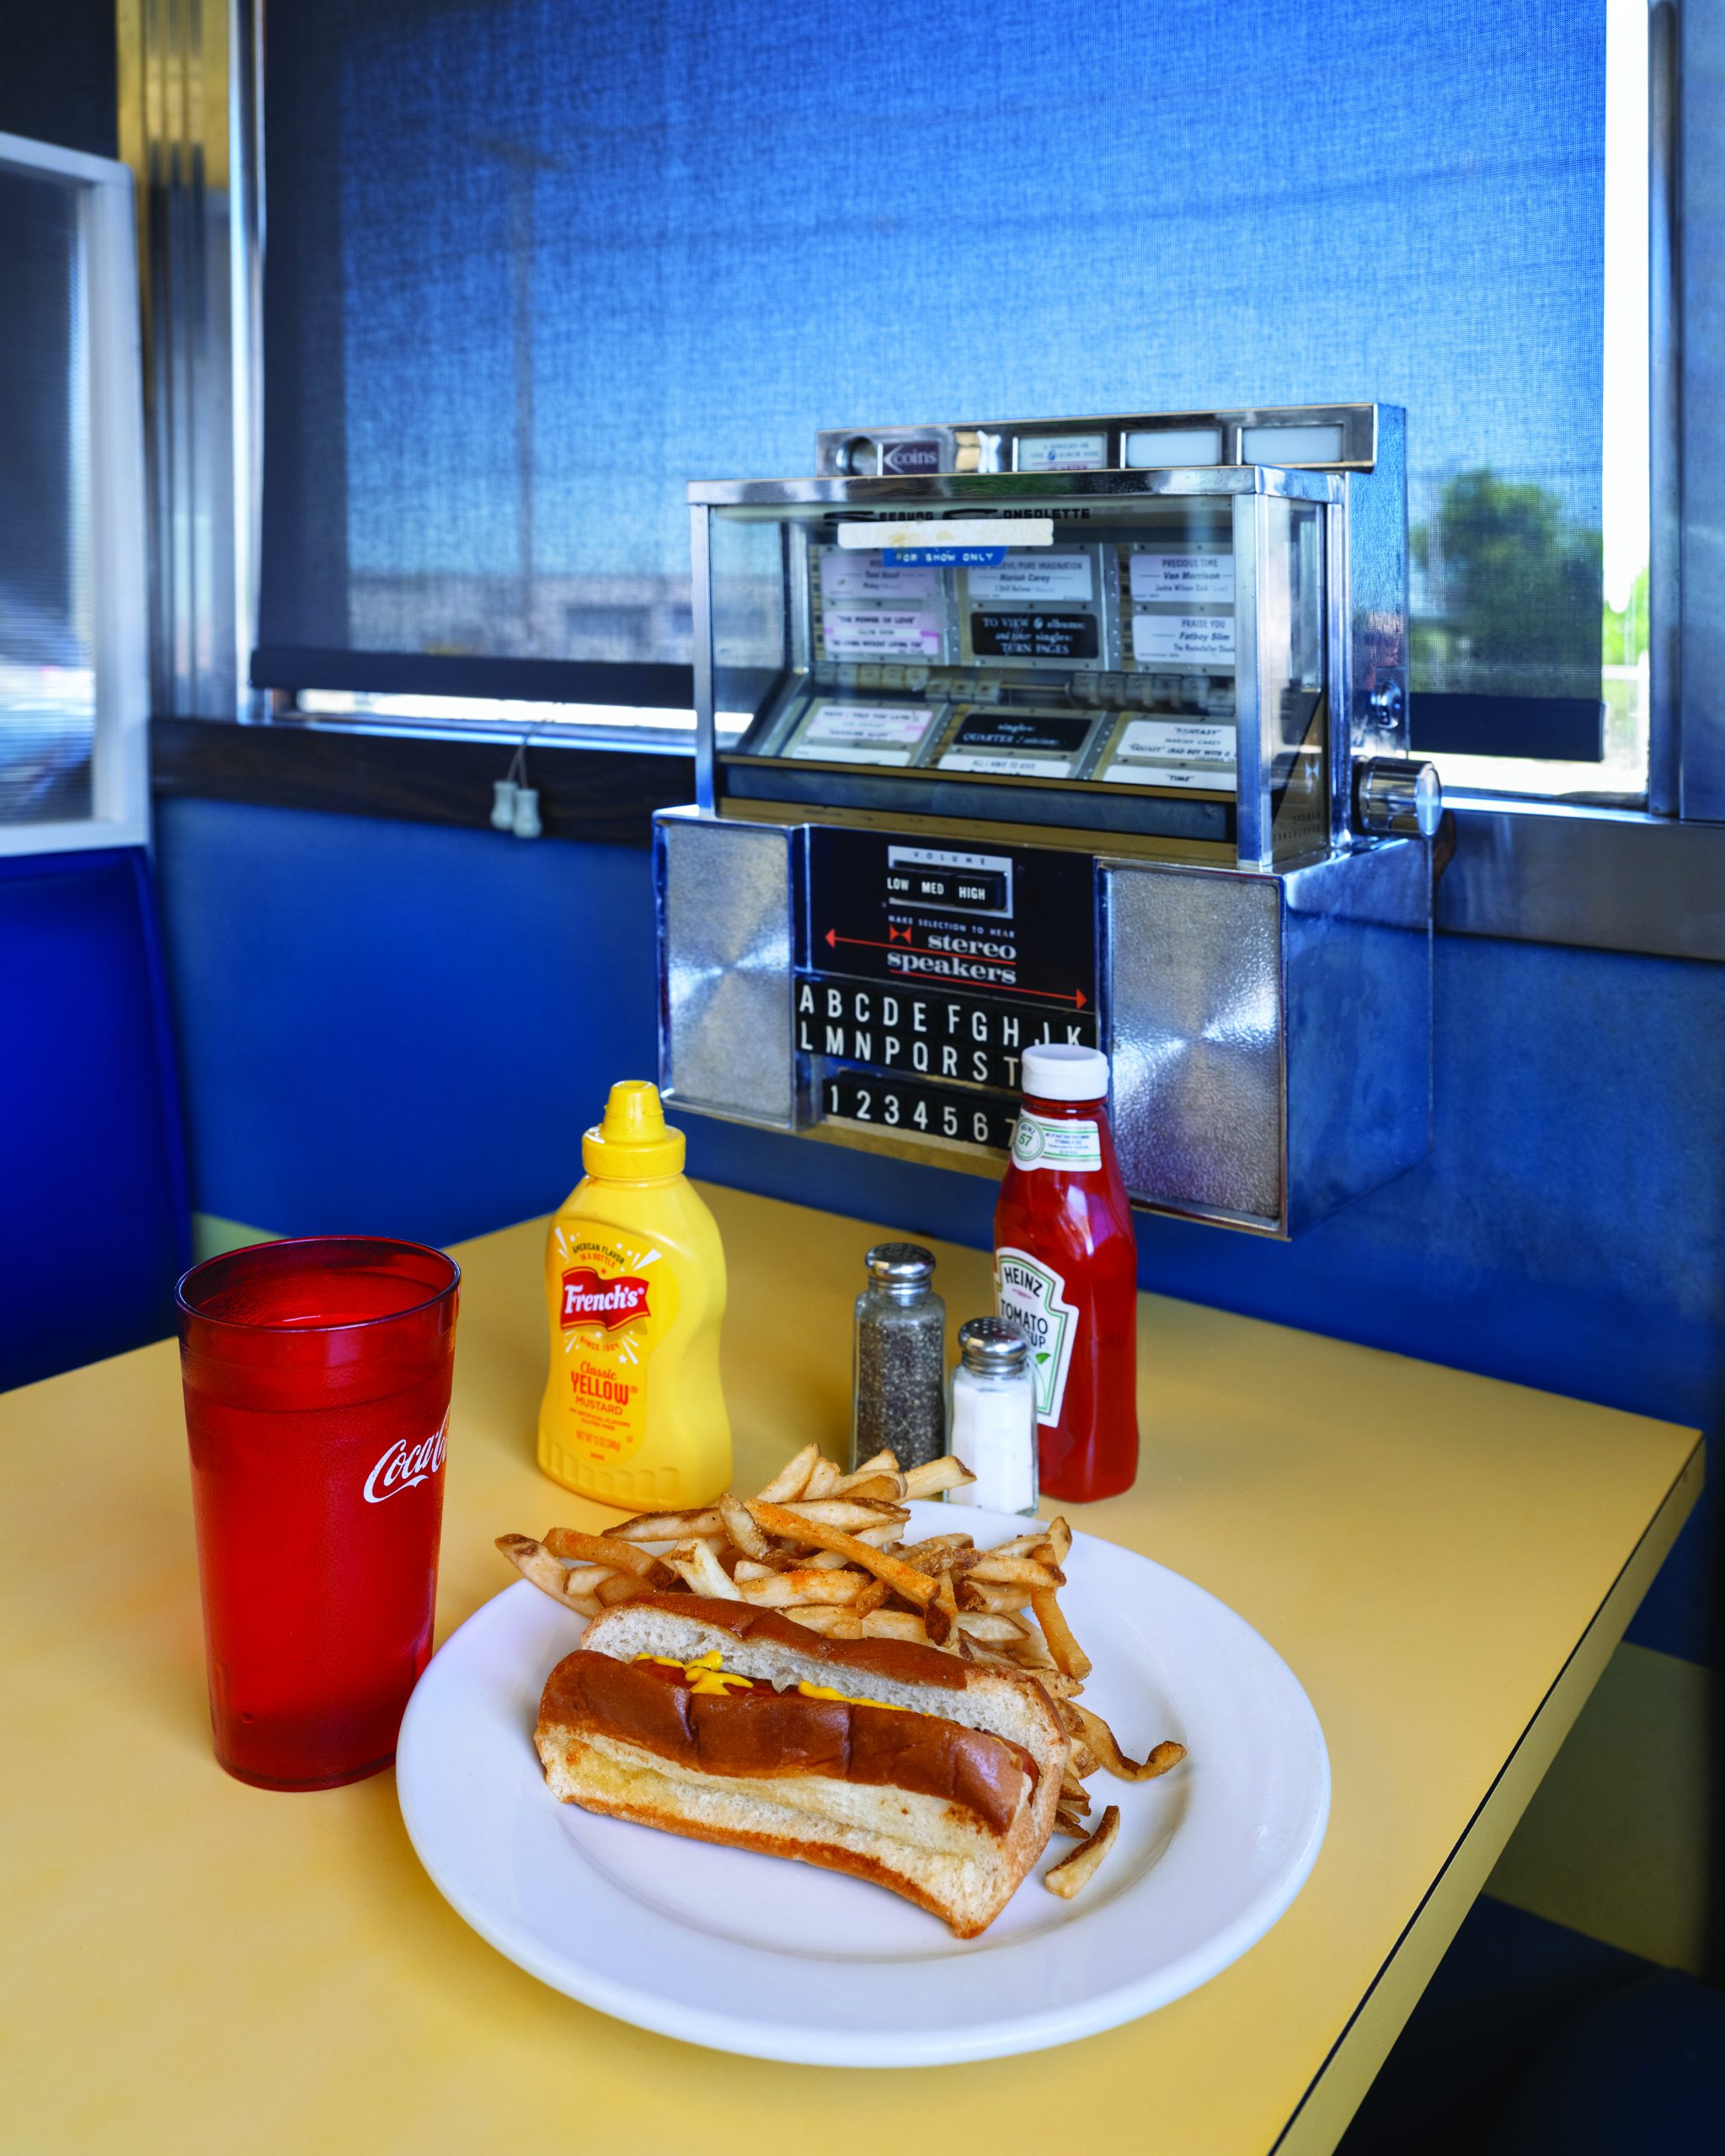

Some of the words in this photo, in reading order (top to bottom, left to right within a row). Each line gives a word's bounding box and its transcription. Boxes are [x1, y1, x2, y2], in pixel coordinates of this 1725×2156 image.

[893, 447, 937, 464] coins
[926, 552, 956, 563] SHOW
[963, 552, 994, 562] ONLY
[1163, 572, 1179, 580] Van
[1182, 572, 1220, 580] Morrison
[914, 851, 986, 866] VOLUME
[887, 877, 910, 891] LOW
[921, 881, 944, 895] MED
[959, 886, 985, 900] HIGH
[888, 915, 914, 926] MAKE
[918, 918, 967, 932] SELECTION
[972, 926, 985, 935] TO
[990, 928, 1016, 939] HEAR
[927, 934, 1017, 960] stereo
[887, 952, 1017, 985] speakers
[799, 985, 814, 1014] A
[827, 989, 842, 1018] B
[855, 993, 870, 1022] C
[884, 997, 899, 1026] D
[913, 1002, 927, 1033] E
[948, 1005, 961, 1033] F
[972, 1011, 988, 1042] G
[1003, 1016, 1019, 1047] H
[1066, 1025, 1082, 1046] K
[801, 1021, 814, 1050] L
[825, 1025, 844, 1056] M
[855, 1030, 871, 1061] N
[885, 1036, 900, 1065] P
[912, 1042, 928, 1072] Q
[943, 1046, 958, 1076] R
[972, 1051, 989, 1081] S
[1002, 1056, 1019, 1086] T
[830, 1085, 839, 1113] 1
[856, 1090, 871, 1120] 2
[884, 1095, 900, 1124] 3
[912, 1101, 928, 1130] 4
[943, 1106, 959, 1136] 5
[973, 1112, 989, 1142] 6
[1018, 1133, 1033, 1146] 57
[1020, 1123, 1036, 1135] HEINZ
[573, 1242, 600, 1254] AMERICAN
[601, 1246, 625, 1265] FLAVOR
[1004, 1267, 1043, 1298] HEINZ
[564, 1284, 638, 1314] French's
[1001, 1299, 1049, 1334] TOMATO
[580, 1361, 617, 1380] Classic
[570, 1371, 629, 1406] YELLOW
[575, 1396, 623, 1416] MUSTARD
